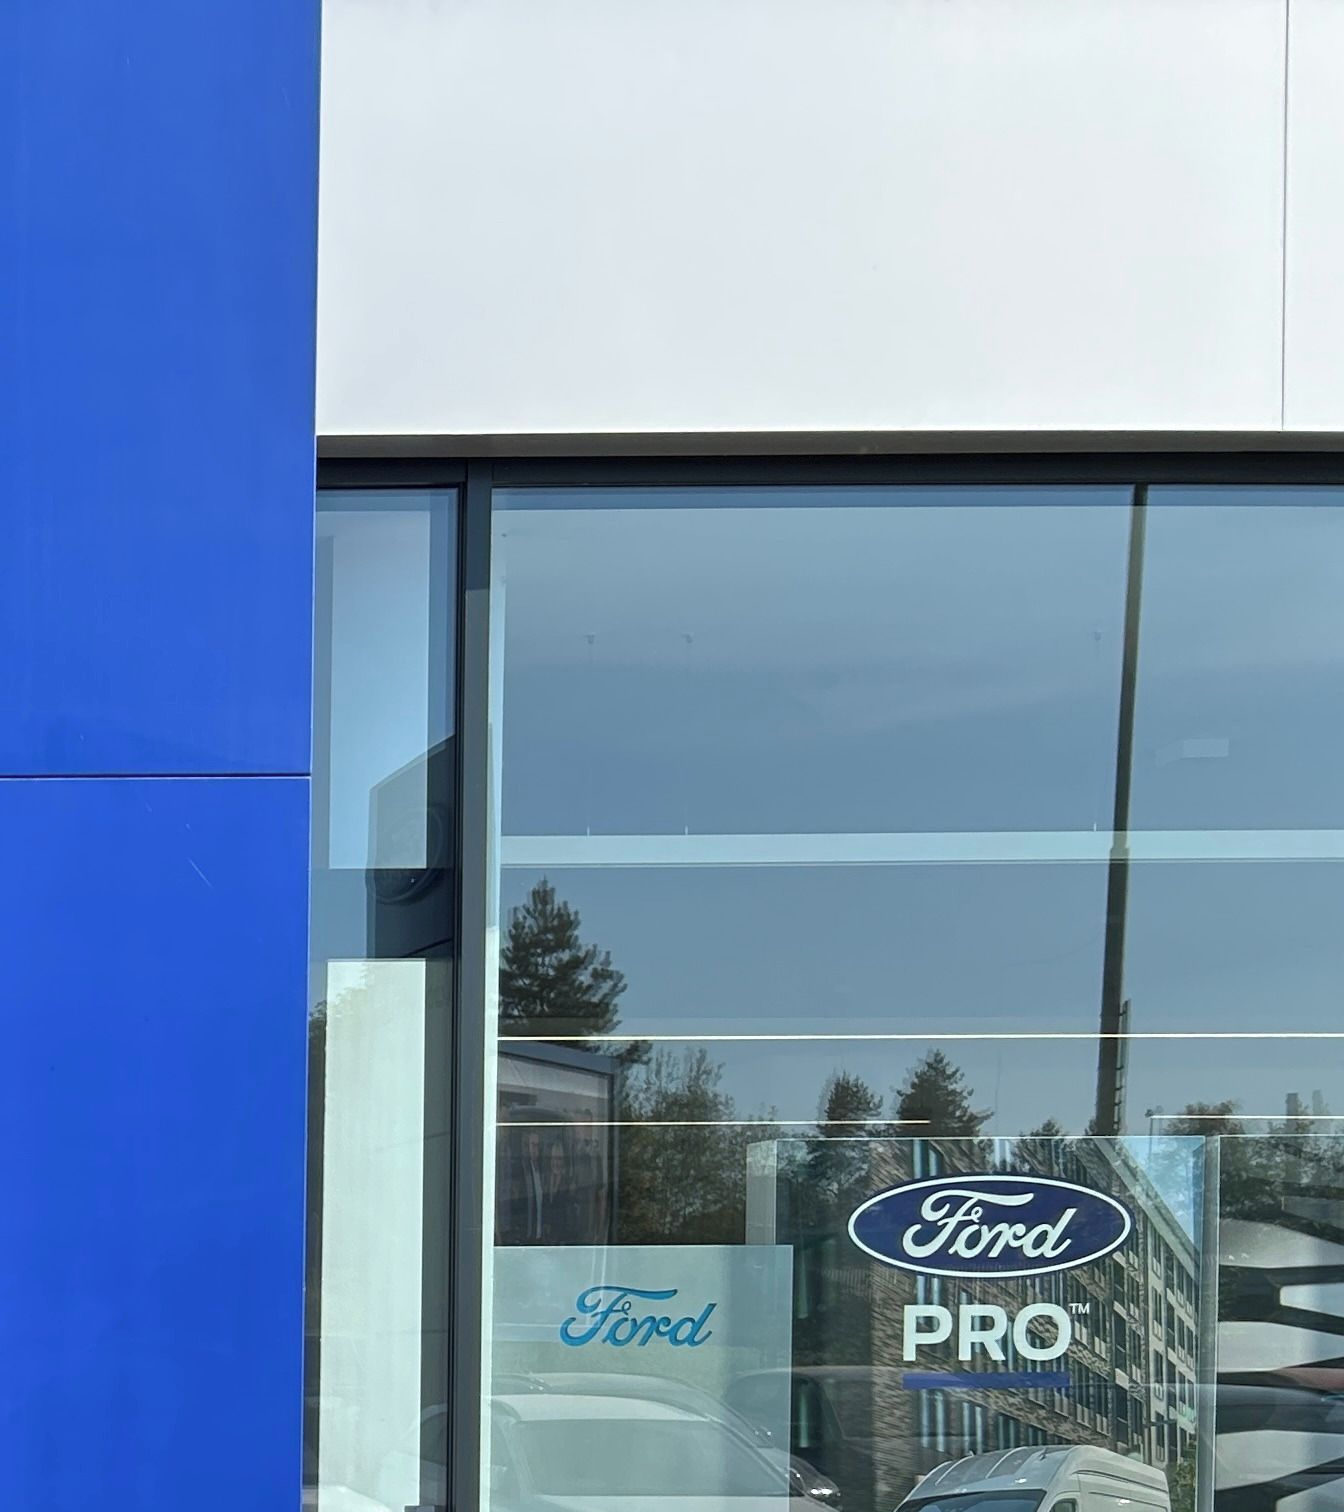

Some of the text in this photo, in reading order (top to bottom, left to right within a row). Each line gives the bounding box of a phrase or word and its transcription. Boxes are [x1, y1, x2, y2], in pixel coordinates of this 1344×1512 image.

[901, 1188, 1077, 1260] Ford
[559, 1285, 717, 1347] Ford
[902, 1303, 1072, 1361] PRO
